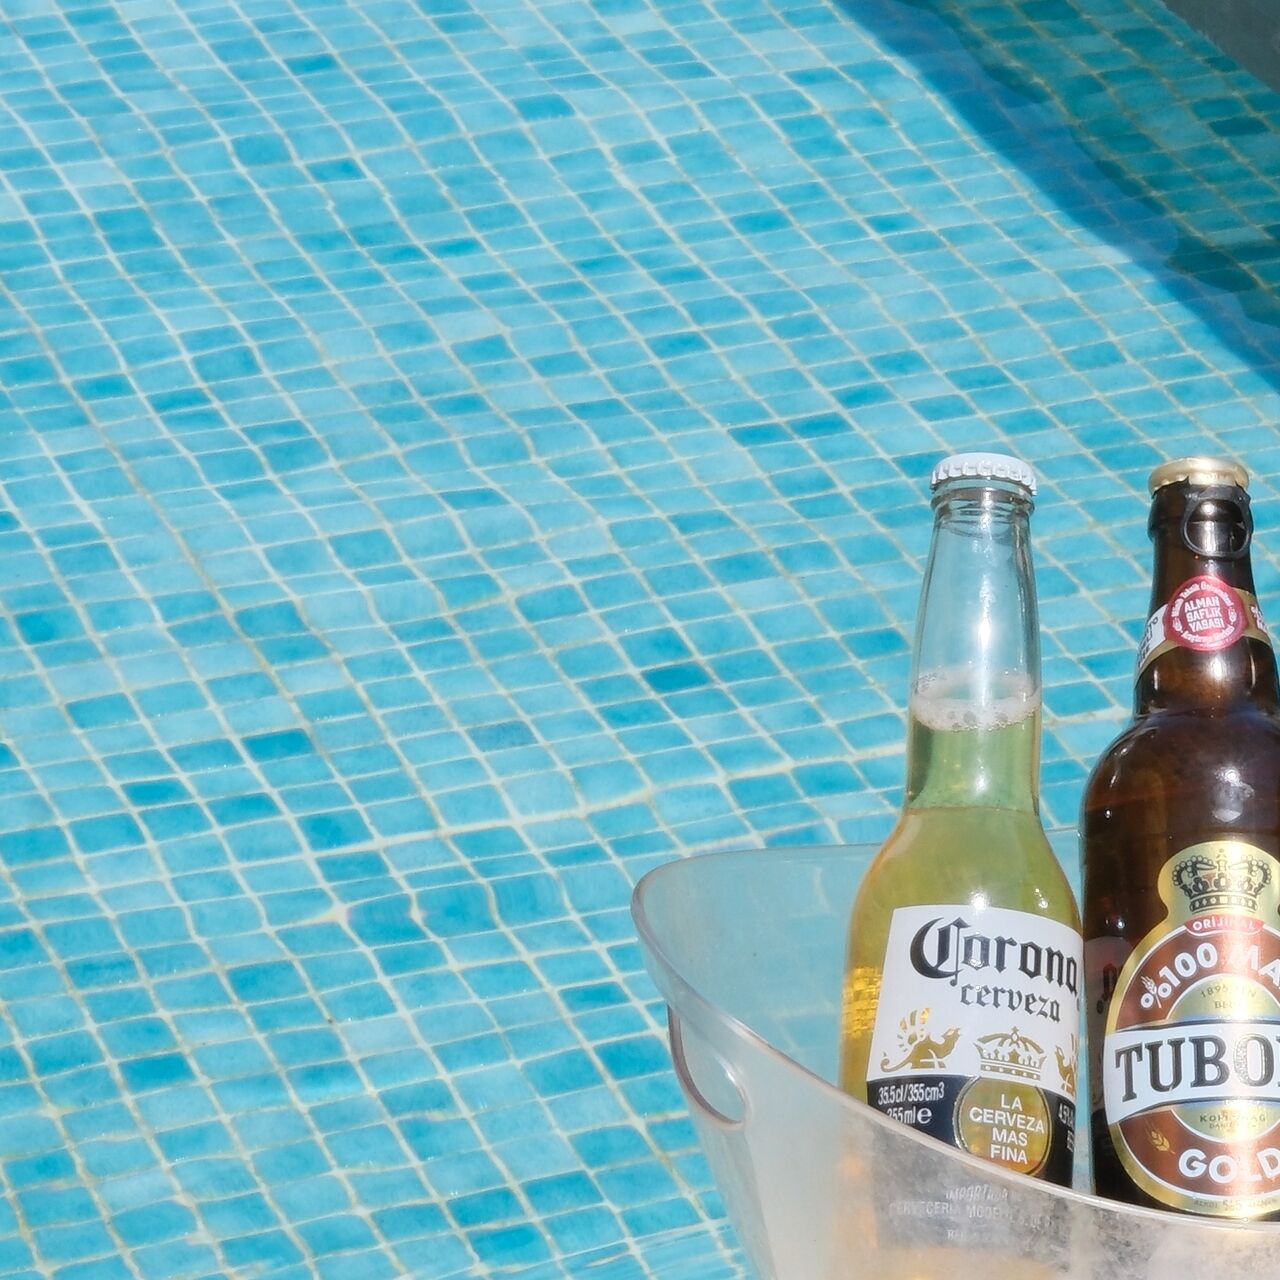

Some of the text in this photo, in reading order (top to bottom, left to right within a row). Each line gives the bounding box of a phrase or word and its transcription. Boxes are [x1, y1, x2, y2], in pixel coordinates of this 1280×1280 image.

[1184, 596, 1220, 613] ALMAN
[1185, 607, 1222, 623] SAFLIK
[1189, 619, 1225, 634] YASASI
[909, 917, 1078, 997] Corona
[1140, 942, 1218, 1009] %100
[959, 983, 1061, 1023] cerveza
[1001, 1093, 1023, 1111] LA
[968, 1106, 1046, 1134] CERVEZA
[992, 1127, 1028, 1145] MAS
[989, 1143, 1029, 1165] FINA
